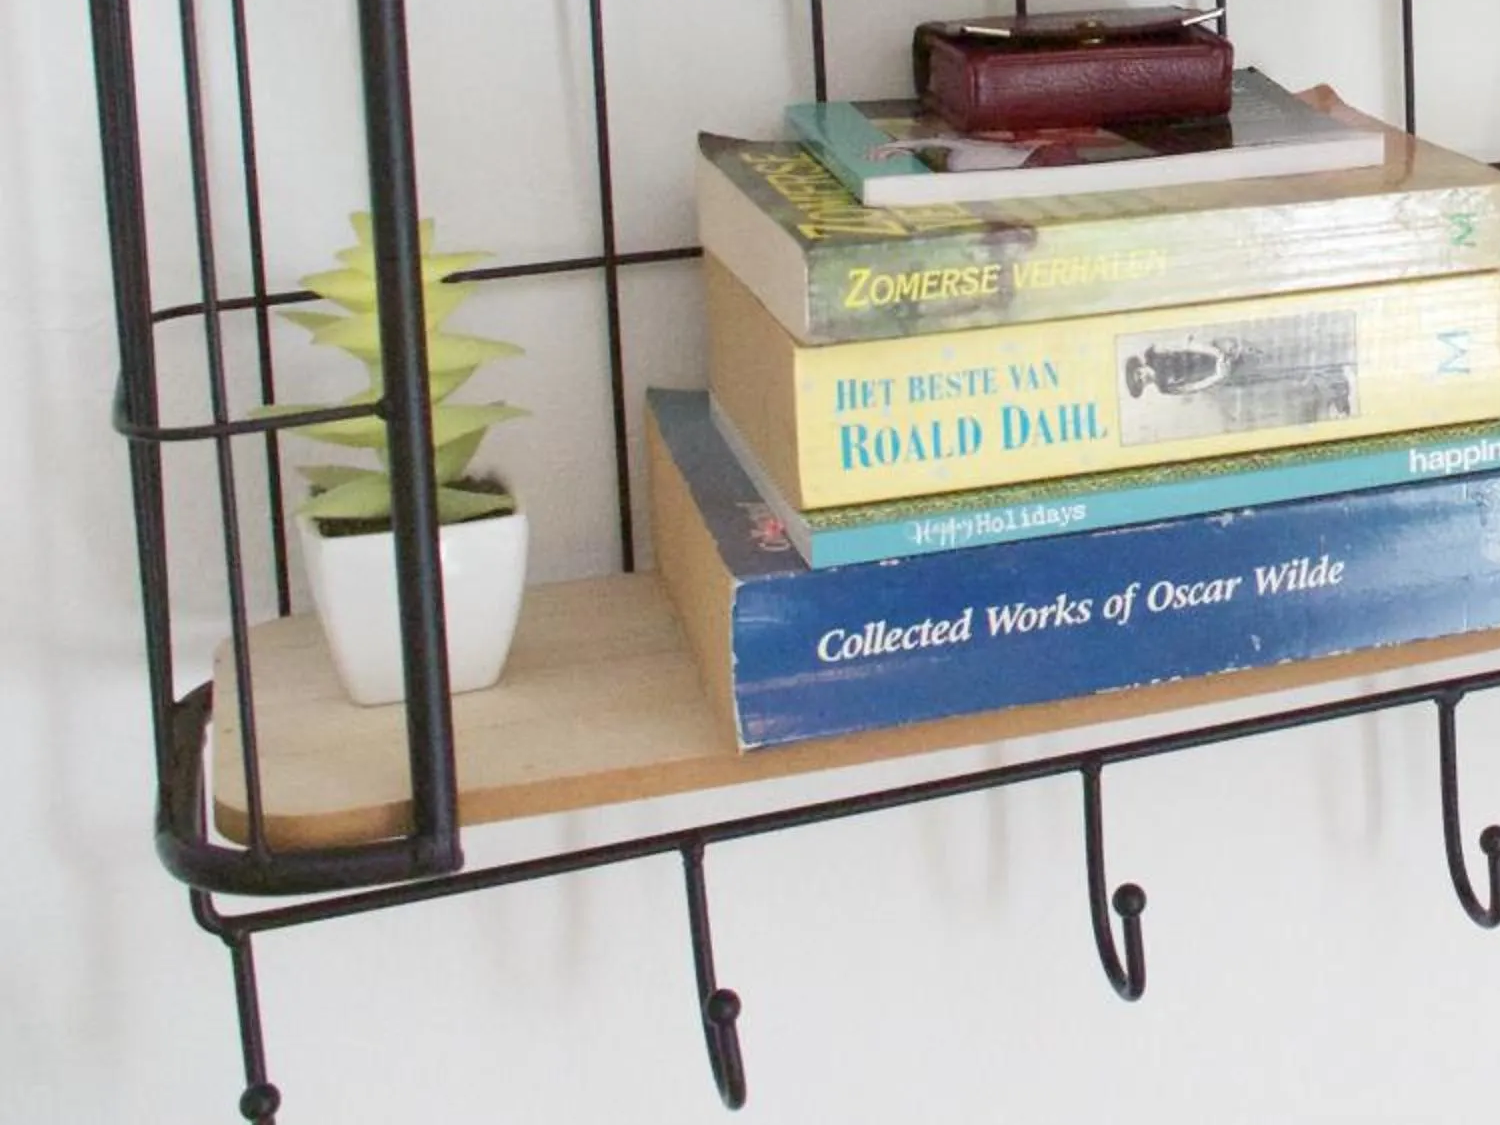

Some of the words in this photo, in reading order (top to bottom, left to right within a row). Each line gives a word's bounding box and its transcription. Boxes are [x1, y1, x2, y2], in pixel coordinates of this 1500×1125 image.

[844, 263, 1001, 308] ZOMERSE
[834, 378, 895, 412] HET
[908, 367, 998, 403] BESTE
[1008, 359, 1060, 391] VAN
[840, 415, 984, 471] ROALD
[1000, 402, 1108, 451] DAHL
[817, 608, 973, 662] Collected
[985, 594, 1093, 636] Works
[1103, 582, 1141, 623] of
[1147, 573, 1242, 614] Oscar
[1253, 555, 1346, 596] Wilde
